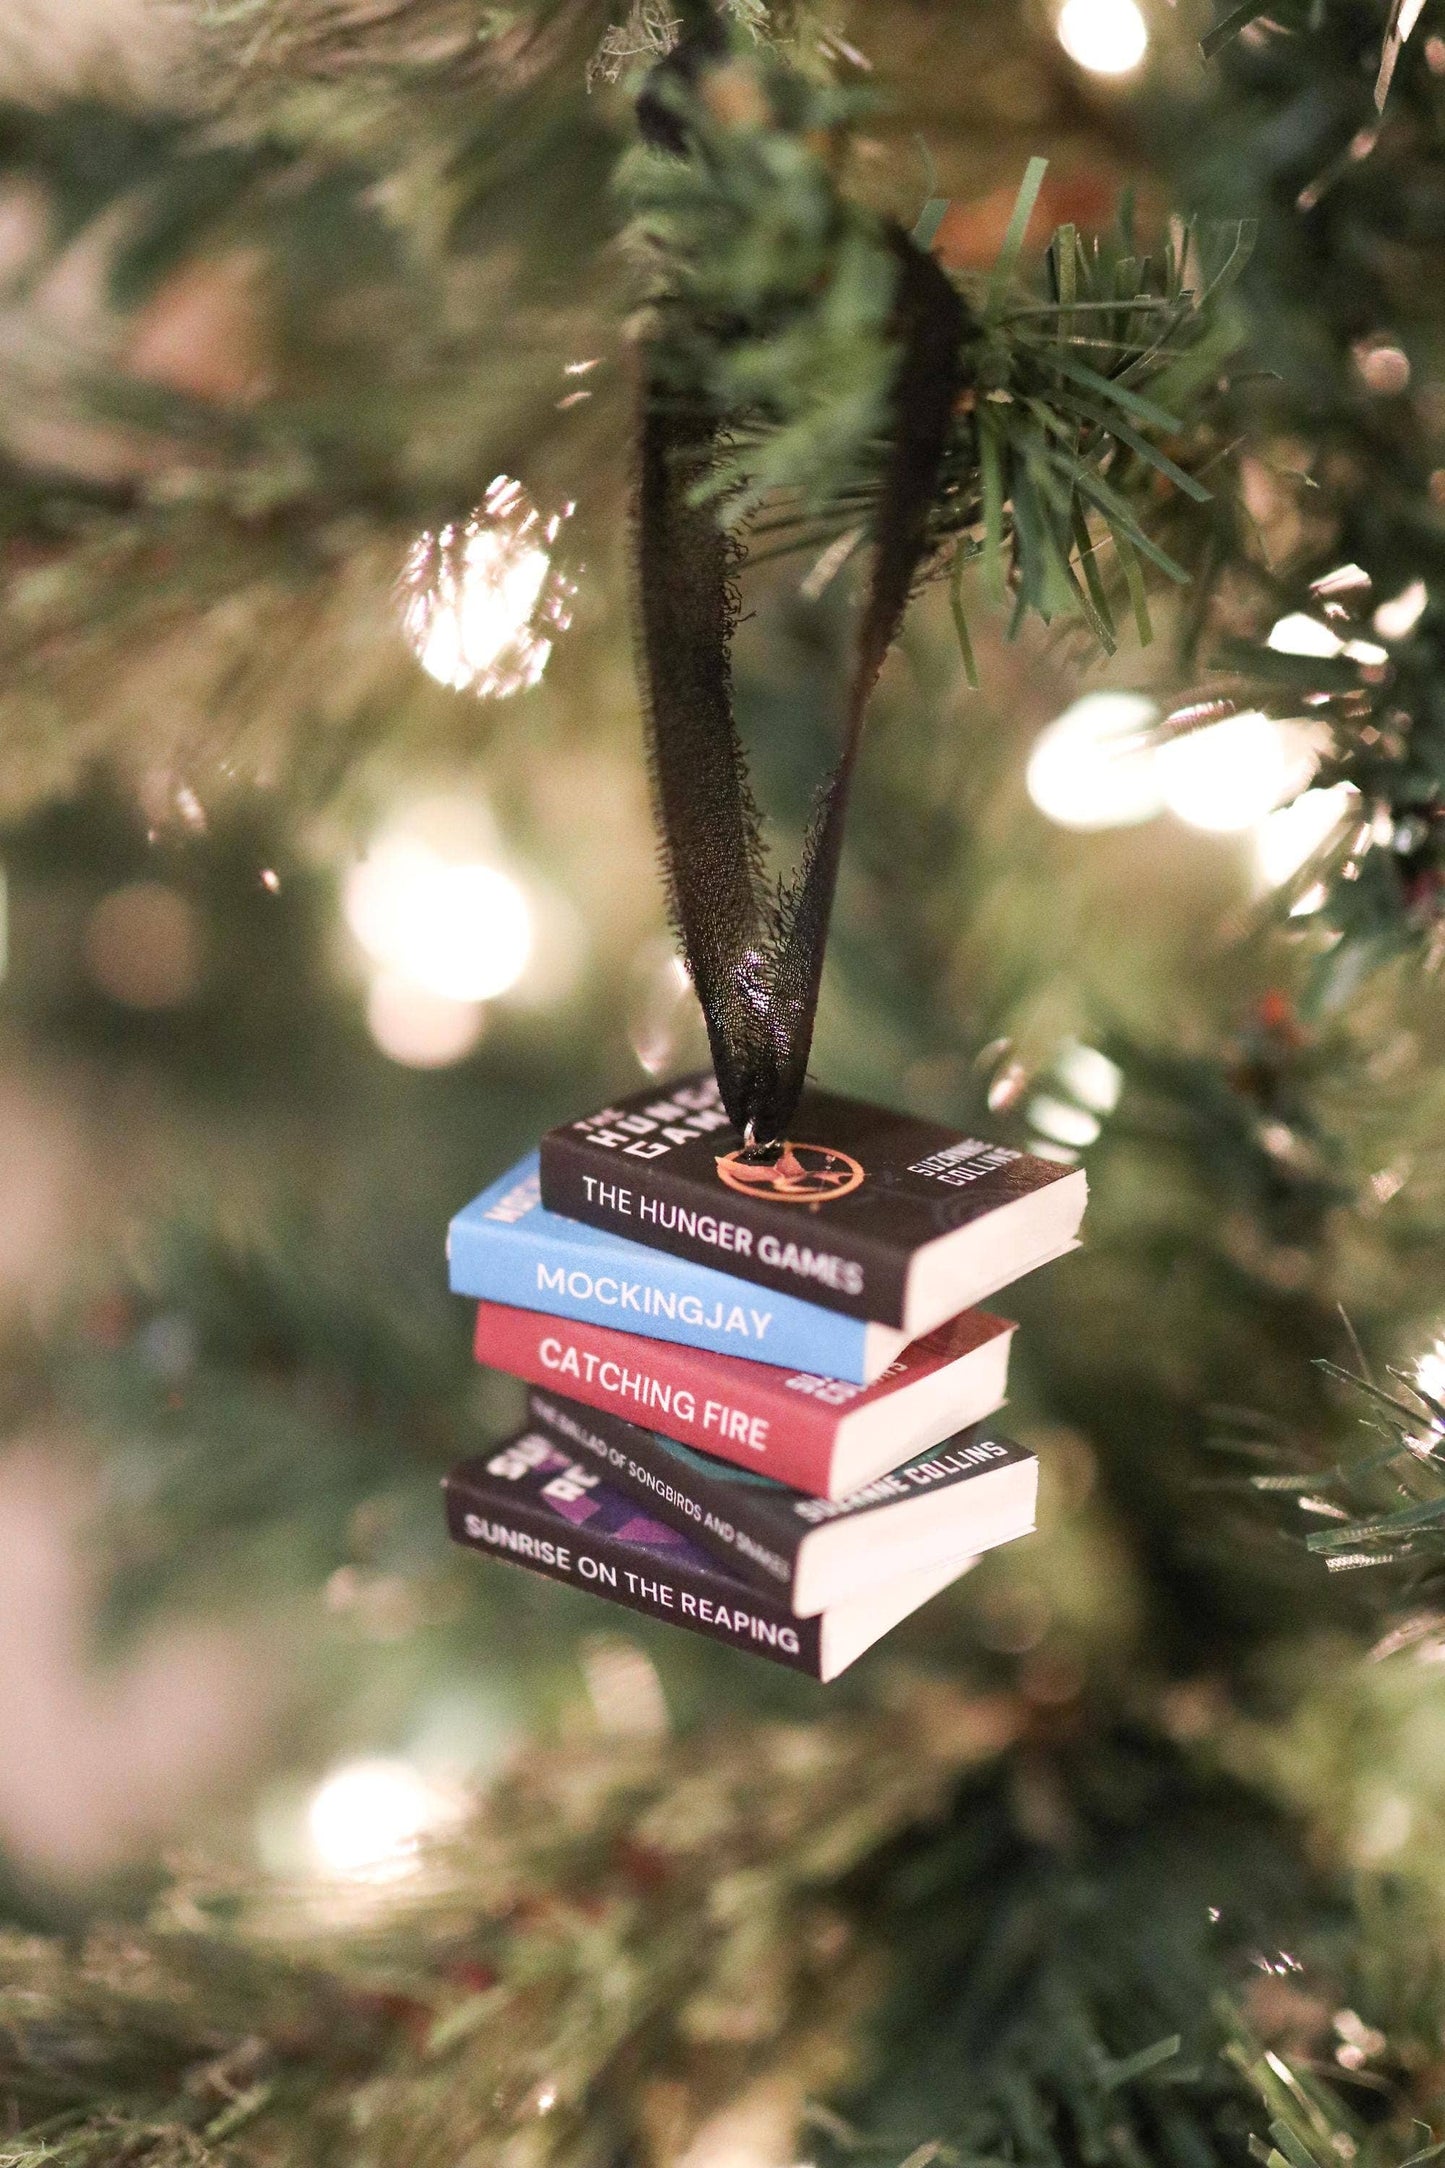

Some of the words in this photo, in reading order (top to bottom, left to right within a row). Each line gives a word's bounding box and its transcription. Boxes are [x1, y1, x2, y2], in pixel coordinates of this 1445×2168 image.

[937, 1147, 1023, 1186] COLLINS
[582, 1175, 632, 1215] THE
[640, 1195, 753, 1256] HUNGER
[757, 1235, 864, 1295] GAMES
[537, 1263, 773, 1340] MOCKINGJAY
[539, 1338, 696, 1423] CATCHING
[703, 1400, 769, 1451] FIRE
[608, 1448, 627, 1468] OF
[628, 1461, 702, 1521] SONGBIRDS
[703, 1512, 735, 1543] AND
[903, 1441, 1009, 1485] COLLINS
[464, 1513, 572, 1571] SUNRISE
[578, 1556, 617, 1588] ON
[624, 1572, 674, 1608] THE
[681, 1592, 800, 1655] REAPING
